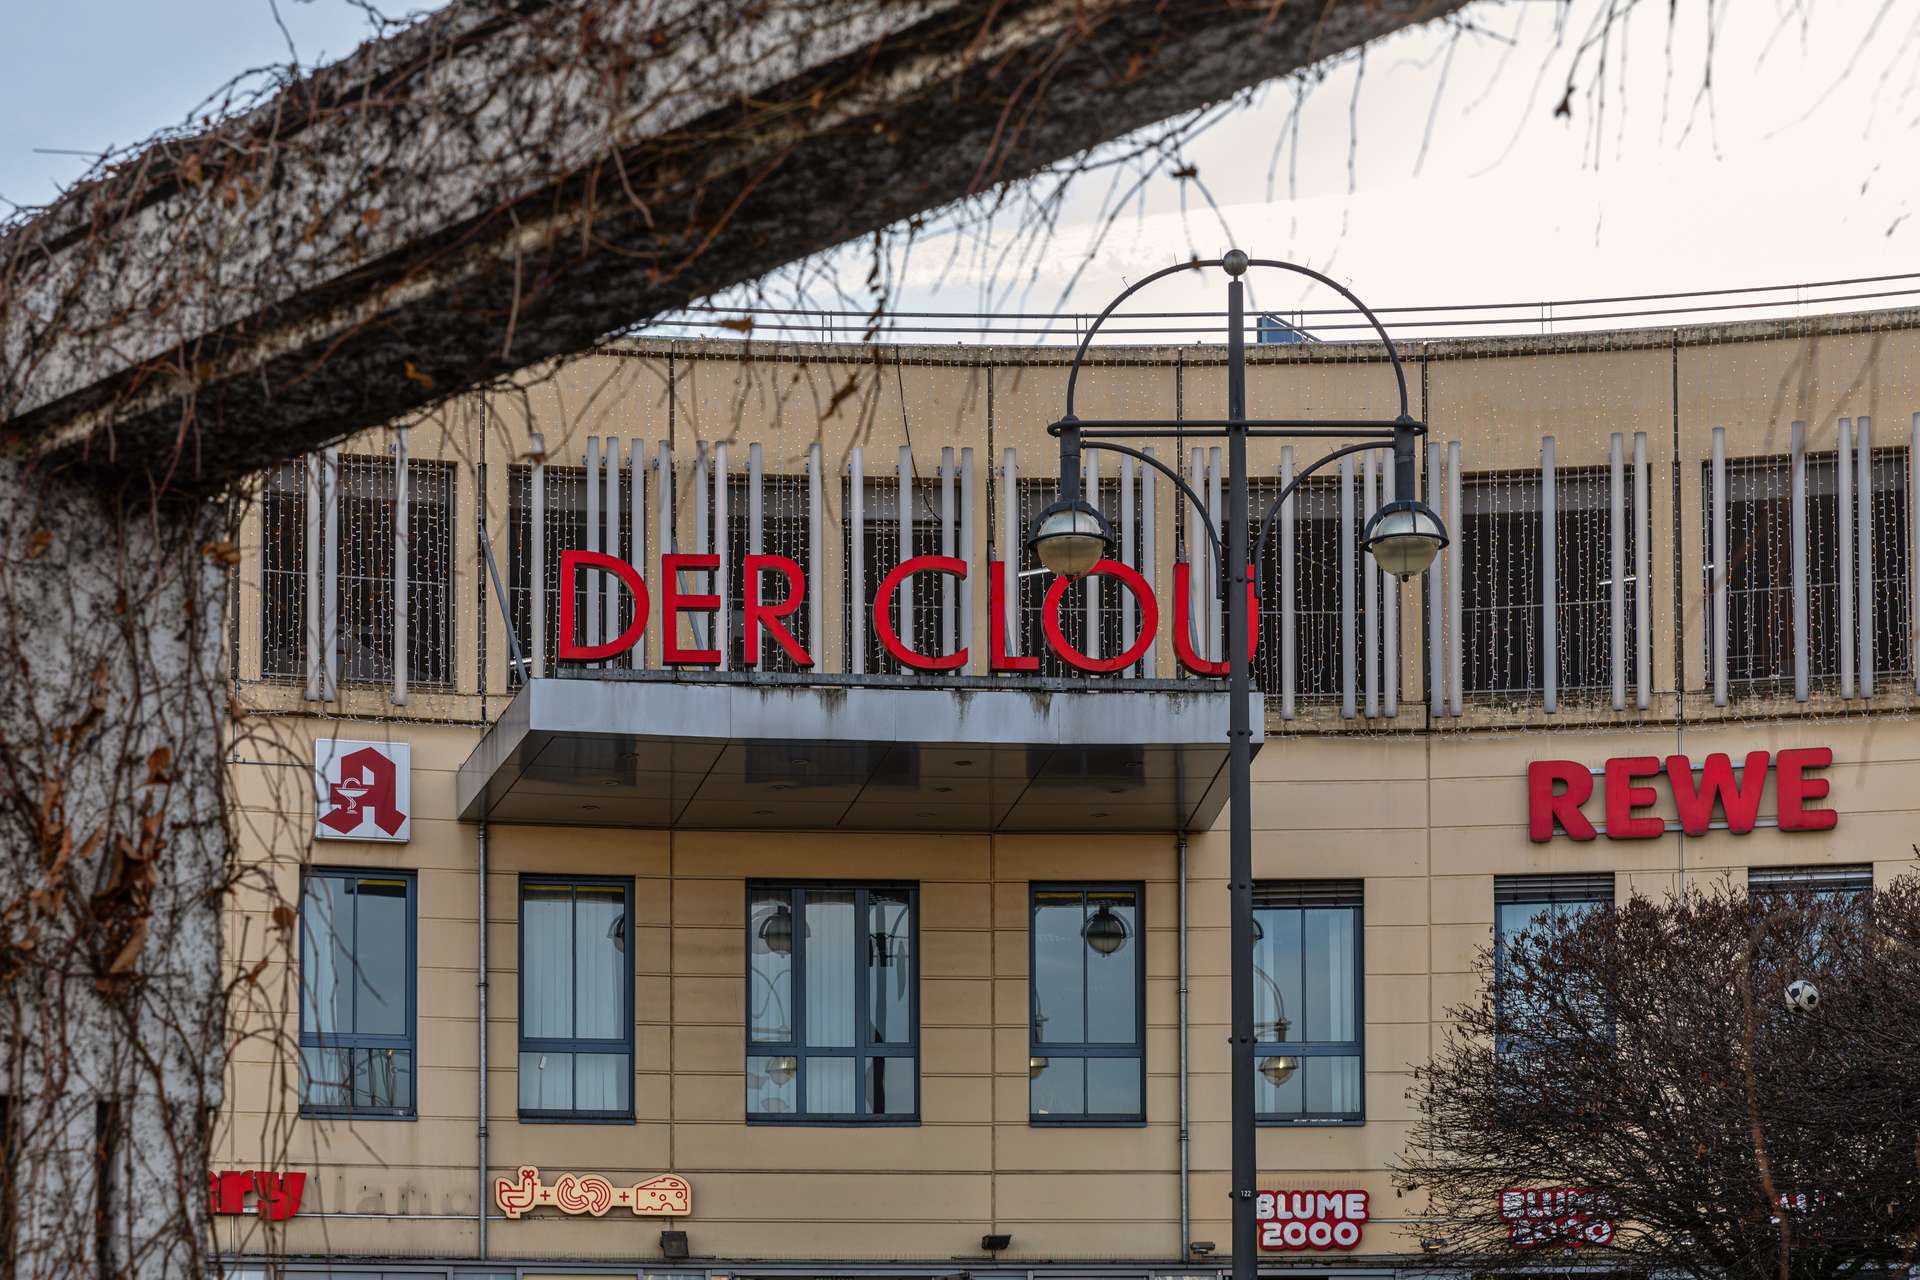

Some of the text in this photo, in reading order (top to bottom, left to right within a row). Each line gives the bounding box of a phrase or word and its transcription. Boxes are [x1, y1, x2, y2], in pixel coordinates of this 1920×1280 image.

[559, 549, 1260, 676] DER CLOU
[1528, 747, 1838, 842] REWE
[1256, 1193, 1366, 1220] BLUME
[1262, 1221, 1359, 1247] 2000
